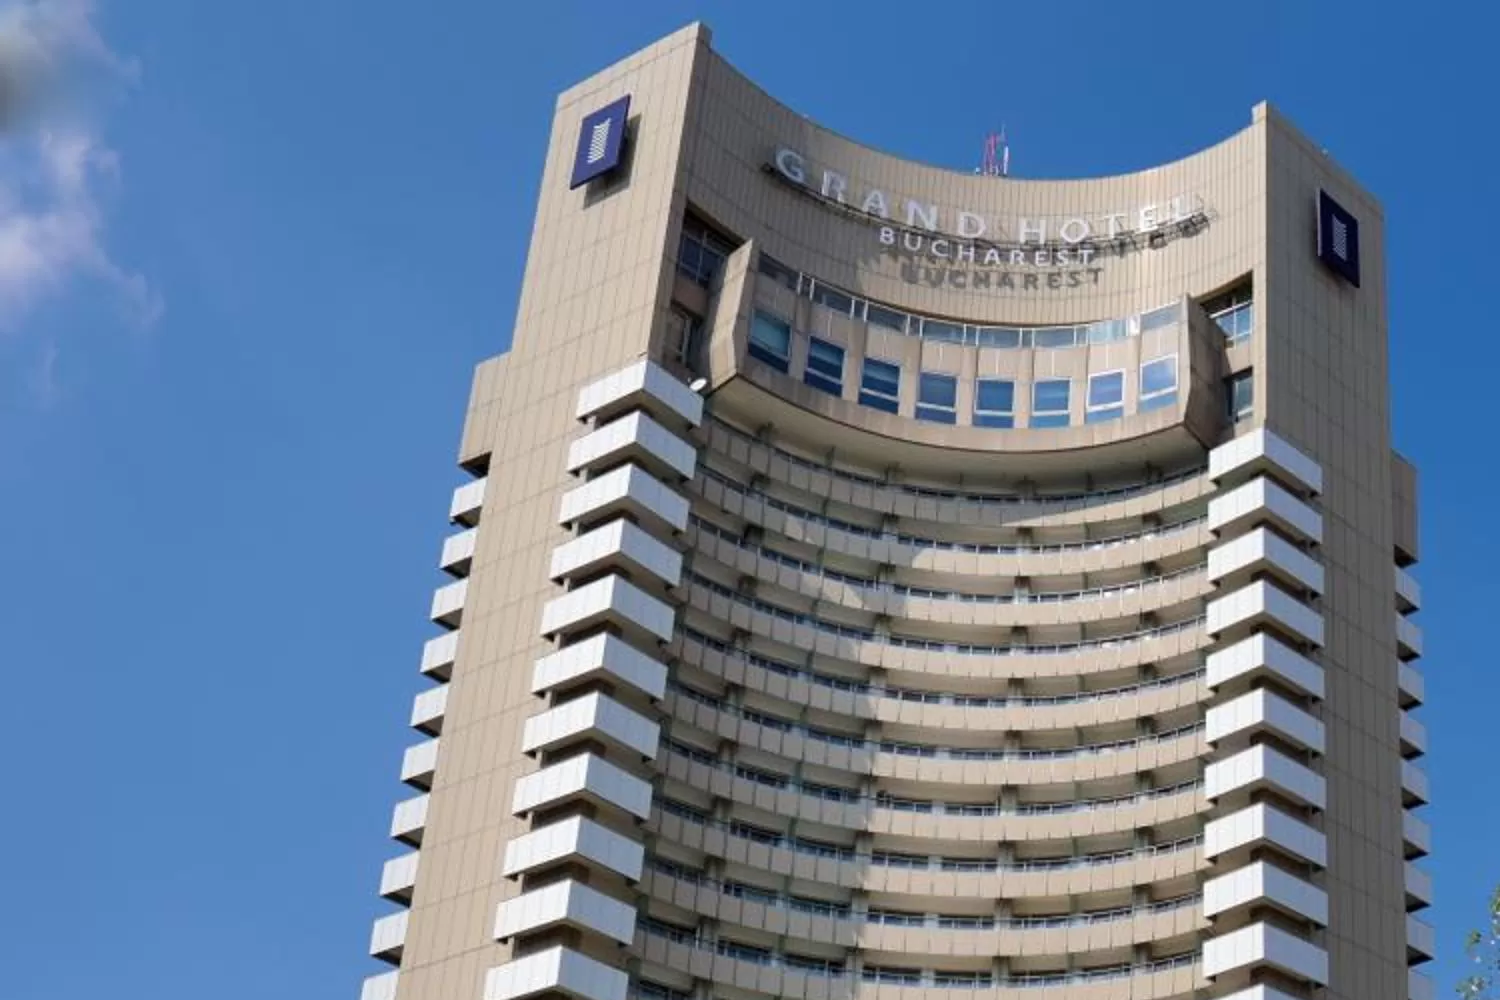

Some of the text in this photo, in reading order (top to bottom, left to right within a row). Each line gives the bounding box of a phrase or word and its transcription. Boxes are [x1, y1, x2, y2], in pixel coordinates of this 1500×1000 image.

[775, 148, 1193, 245] GRAND HOTEL
[879, 226, 1095, 267] BUCHAREST
